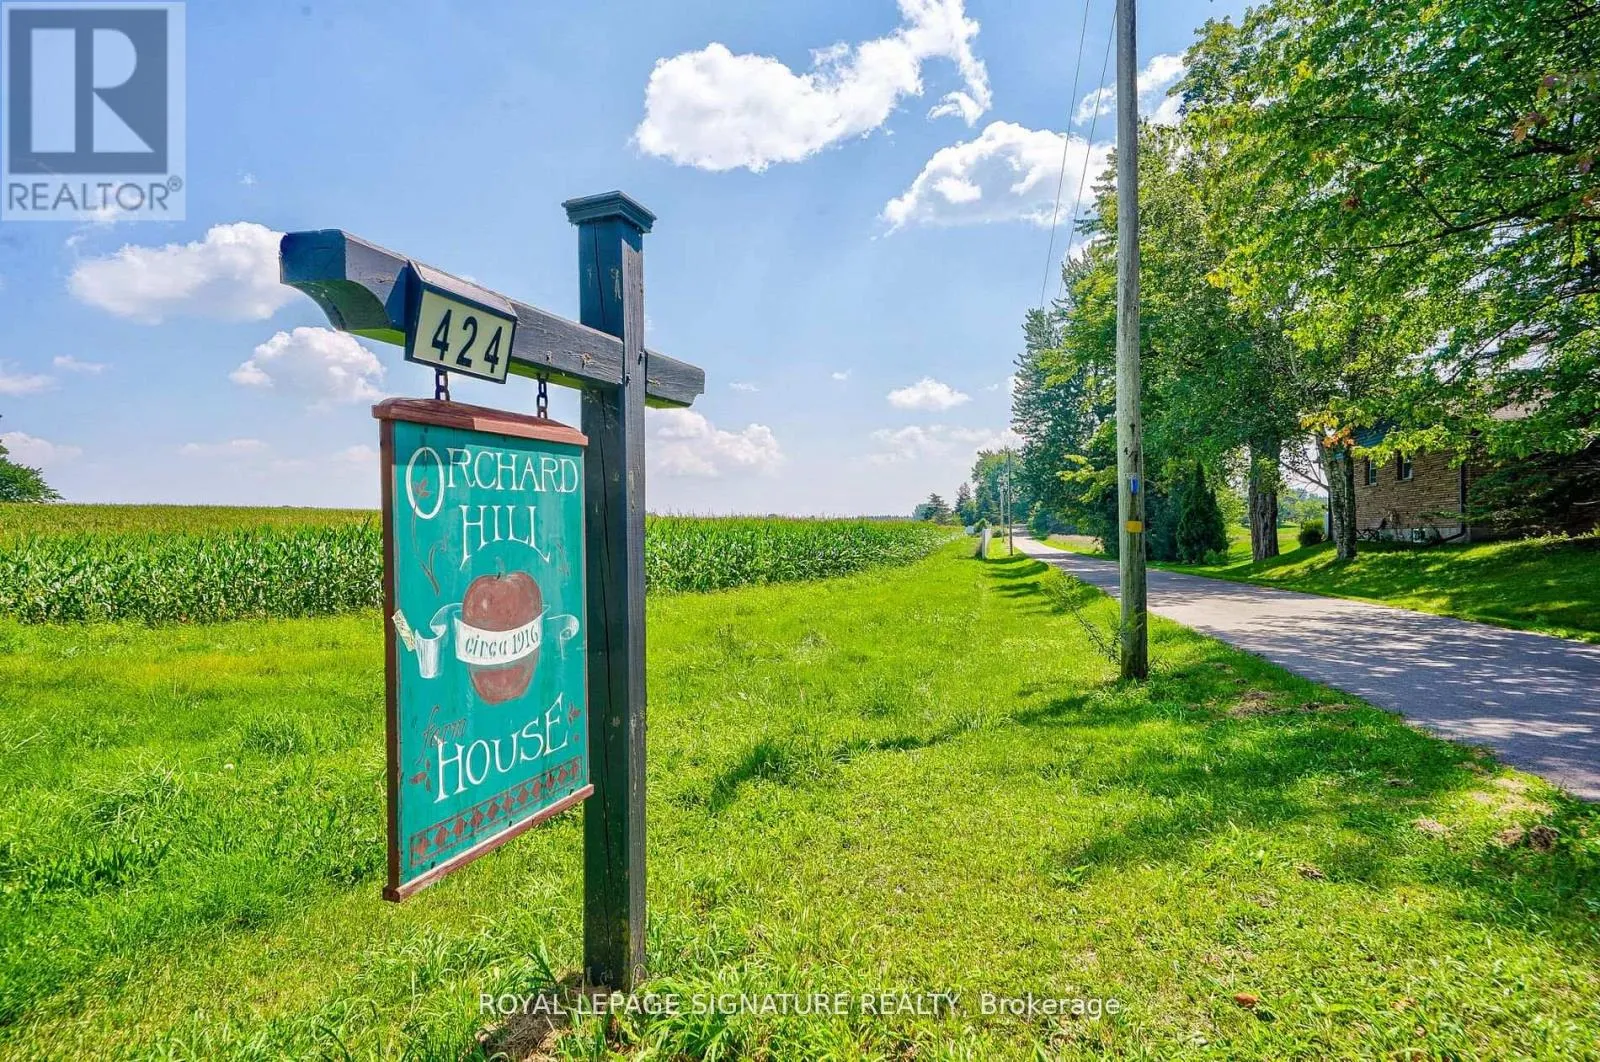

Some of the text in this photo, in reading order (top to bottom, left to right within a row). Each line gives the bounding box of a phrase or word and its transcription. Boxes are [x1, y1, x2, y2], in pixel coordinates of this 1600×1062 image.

[431, 309, 502, 374] 424
[405, 447, 579, 519] ORCHARD
[458, 504, 551, 570] HILL
[465, 624, 539, 658] circa 1916
[433, 692, 569, 804] HOUSE
